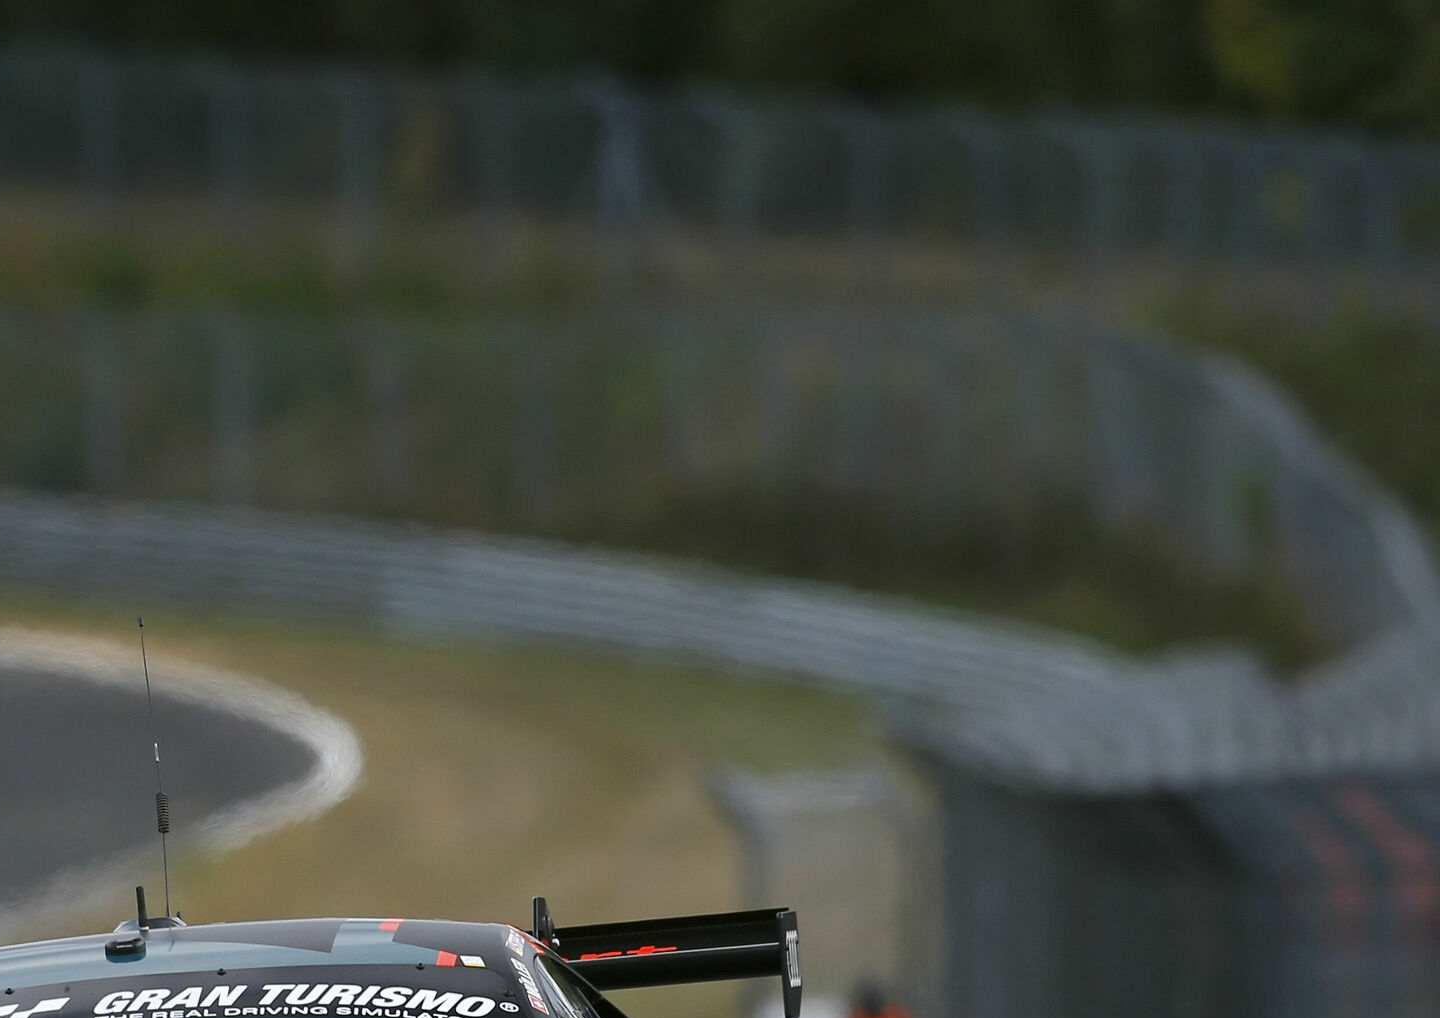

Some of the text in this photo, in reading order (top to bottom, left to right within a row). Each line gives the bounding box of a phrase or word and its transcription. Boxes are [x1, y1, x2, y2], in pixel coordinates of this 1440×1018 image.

[93, 984, 496, 1018] GRAN TURISMO
[225, 1006, 328, 1017] DRIVING
